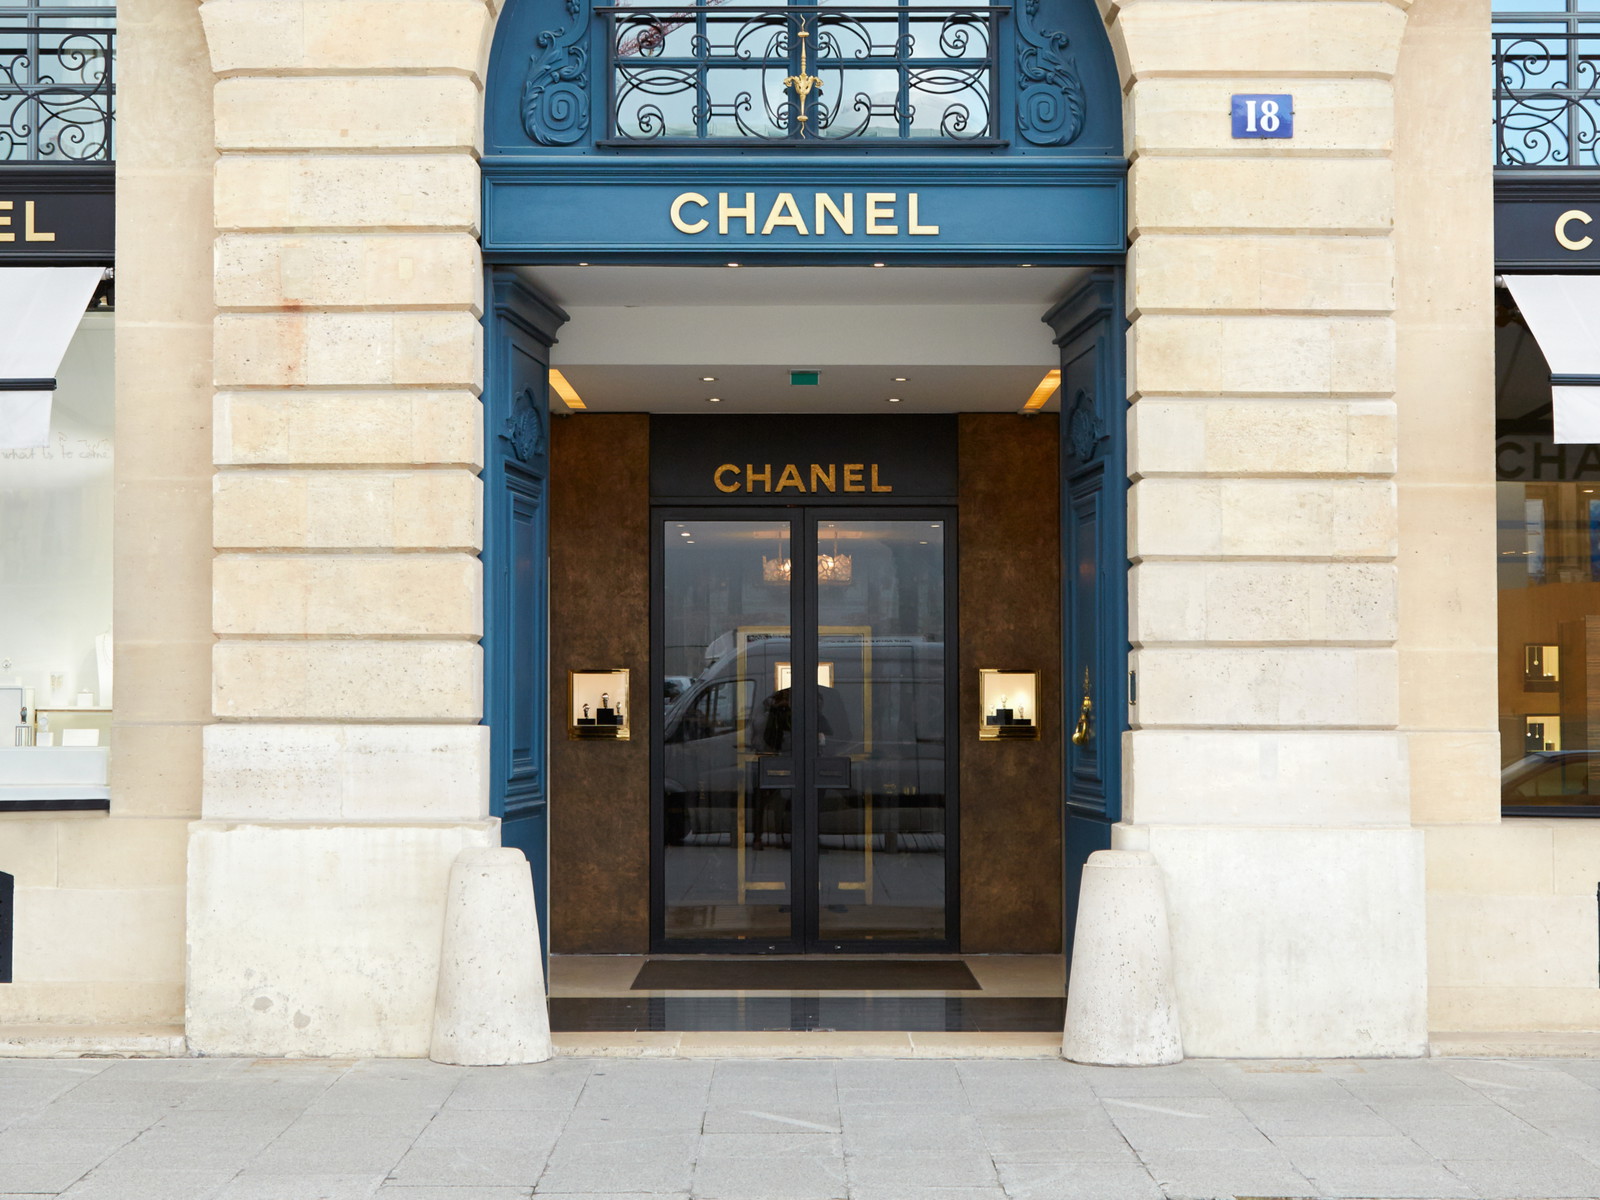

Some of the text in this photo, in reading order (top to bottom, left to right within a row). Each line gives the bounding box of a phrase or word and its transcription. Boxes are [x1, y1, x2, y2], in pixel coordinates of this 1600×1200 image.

[1245, 100, 1280, 132] 18
[670, 192, 940, 235] CHANEL
[1554, 209, 1594, 251] C
[713, 464, 893, 493] CHANEL
